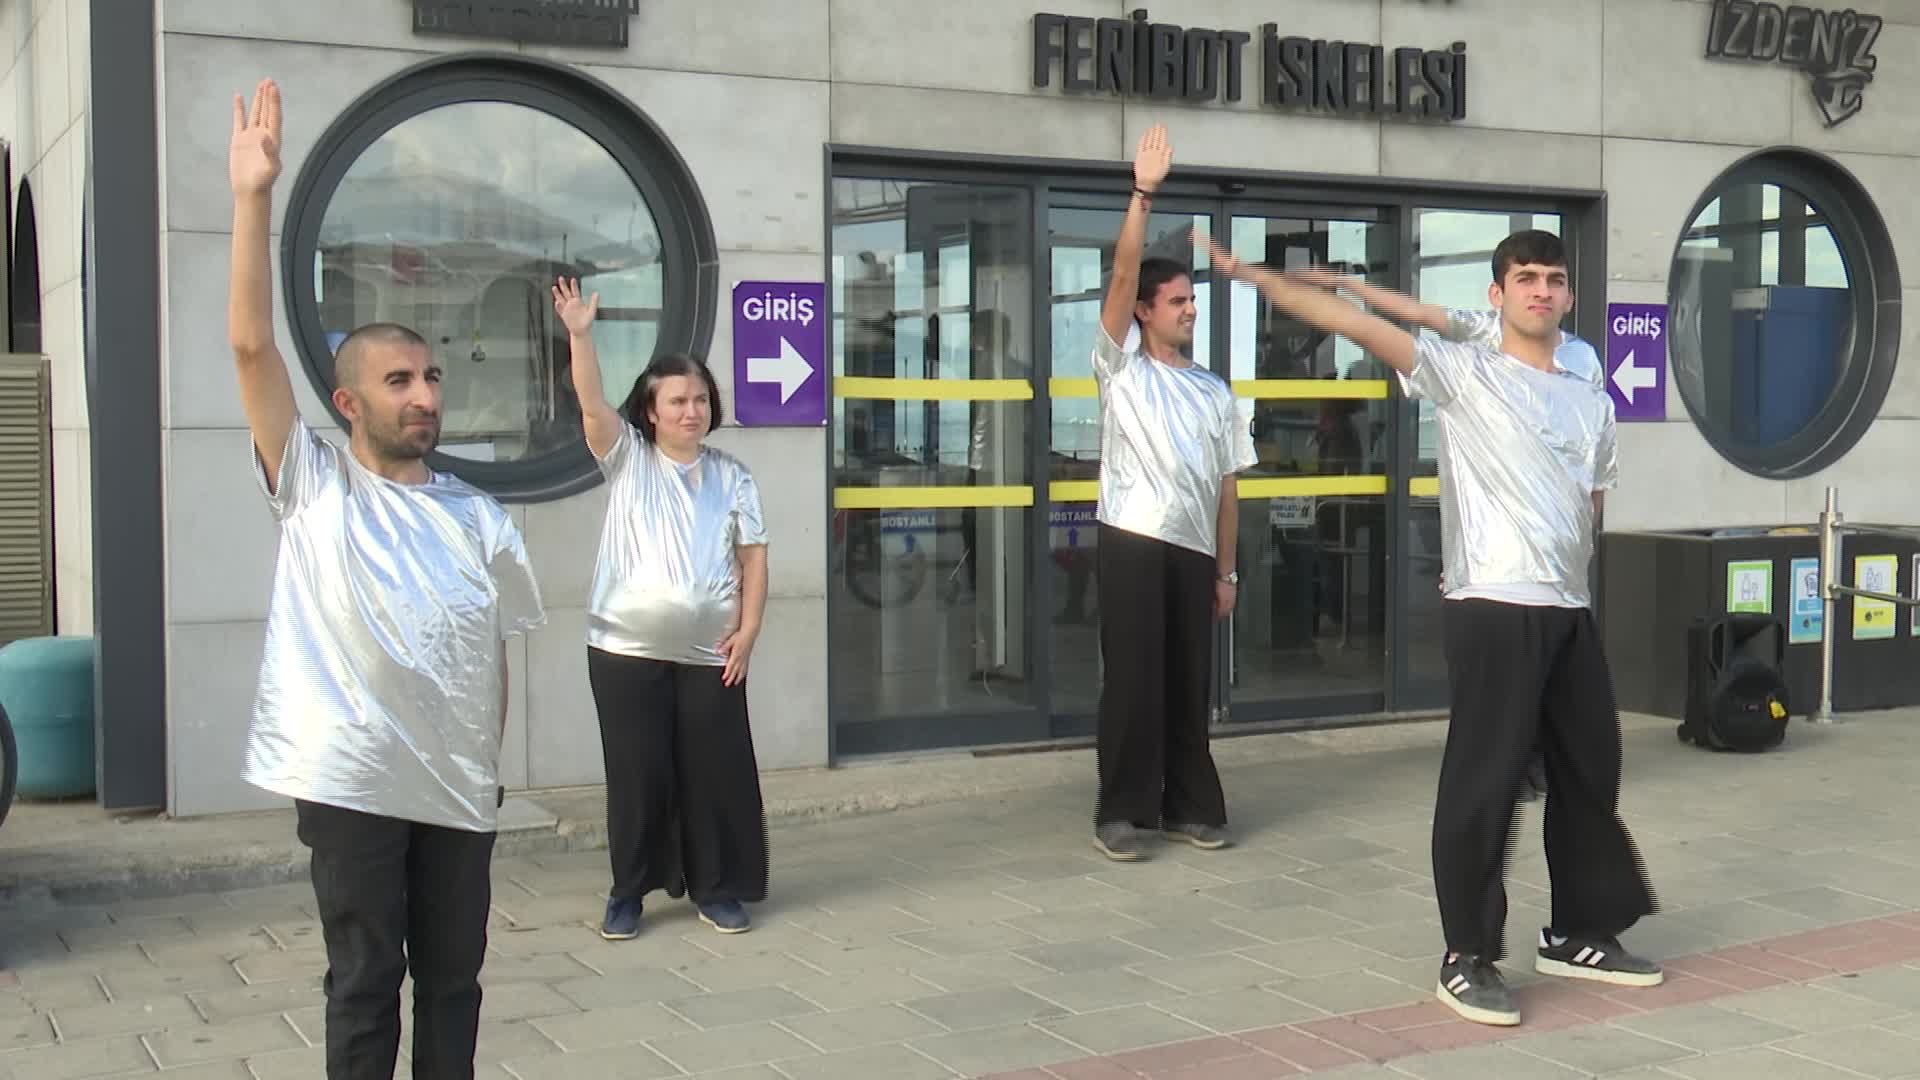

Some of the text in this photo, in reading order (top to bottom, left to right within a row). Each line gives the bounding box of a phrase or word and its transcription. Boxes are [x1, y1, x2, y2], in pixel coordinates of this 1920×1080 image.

[1033, 9, 1467, 120] FERİBOT İSKELESİ
[743, 291, 815, 327] GİRİŞ
[1613, 312, 1661, 341] GİRİŞ
